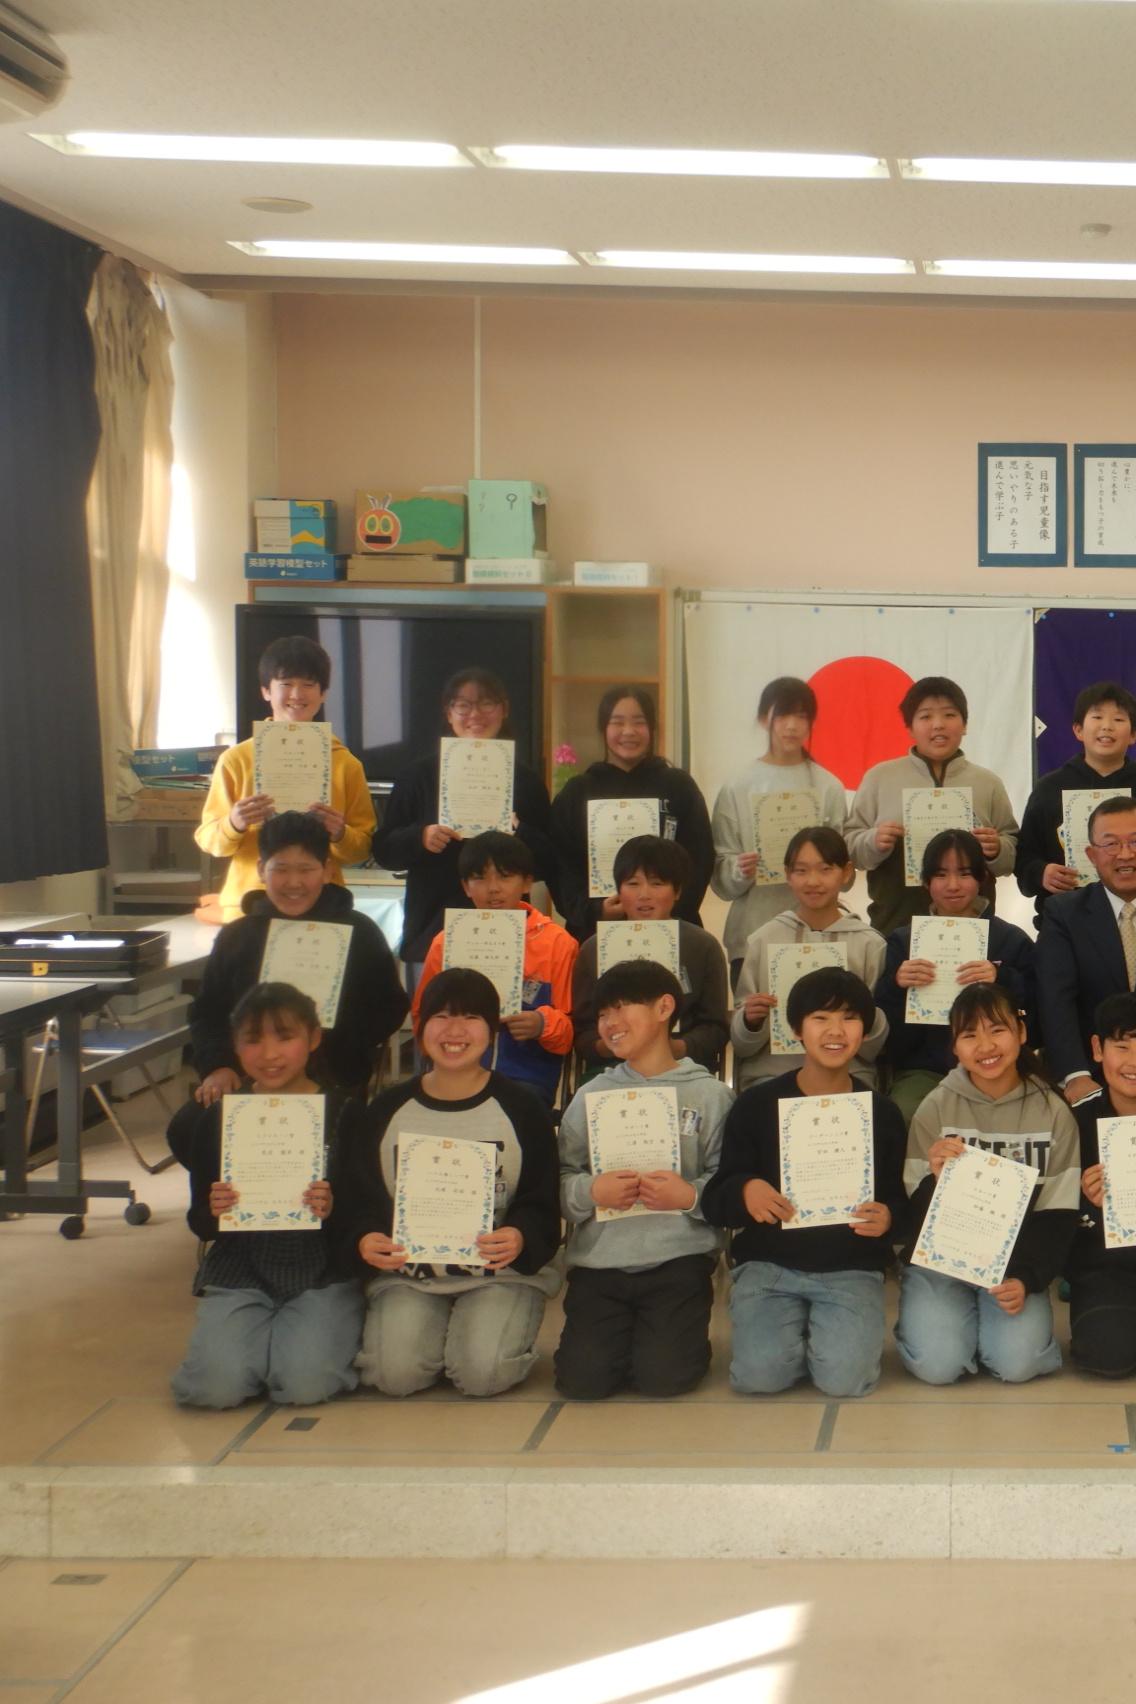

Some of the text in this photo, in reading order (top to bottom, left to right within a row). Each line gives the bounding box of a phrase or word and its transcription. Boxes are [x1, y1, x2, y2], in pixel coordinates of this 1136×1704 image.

[1009, 461, 1019, 549] 思いやりのある子
[1024, 461, 1034, 501] 元気な子
[1040, 470, 1050, 540] 目指す児童像
